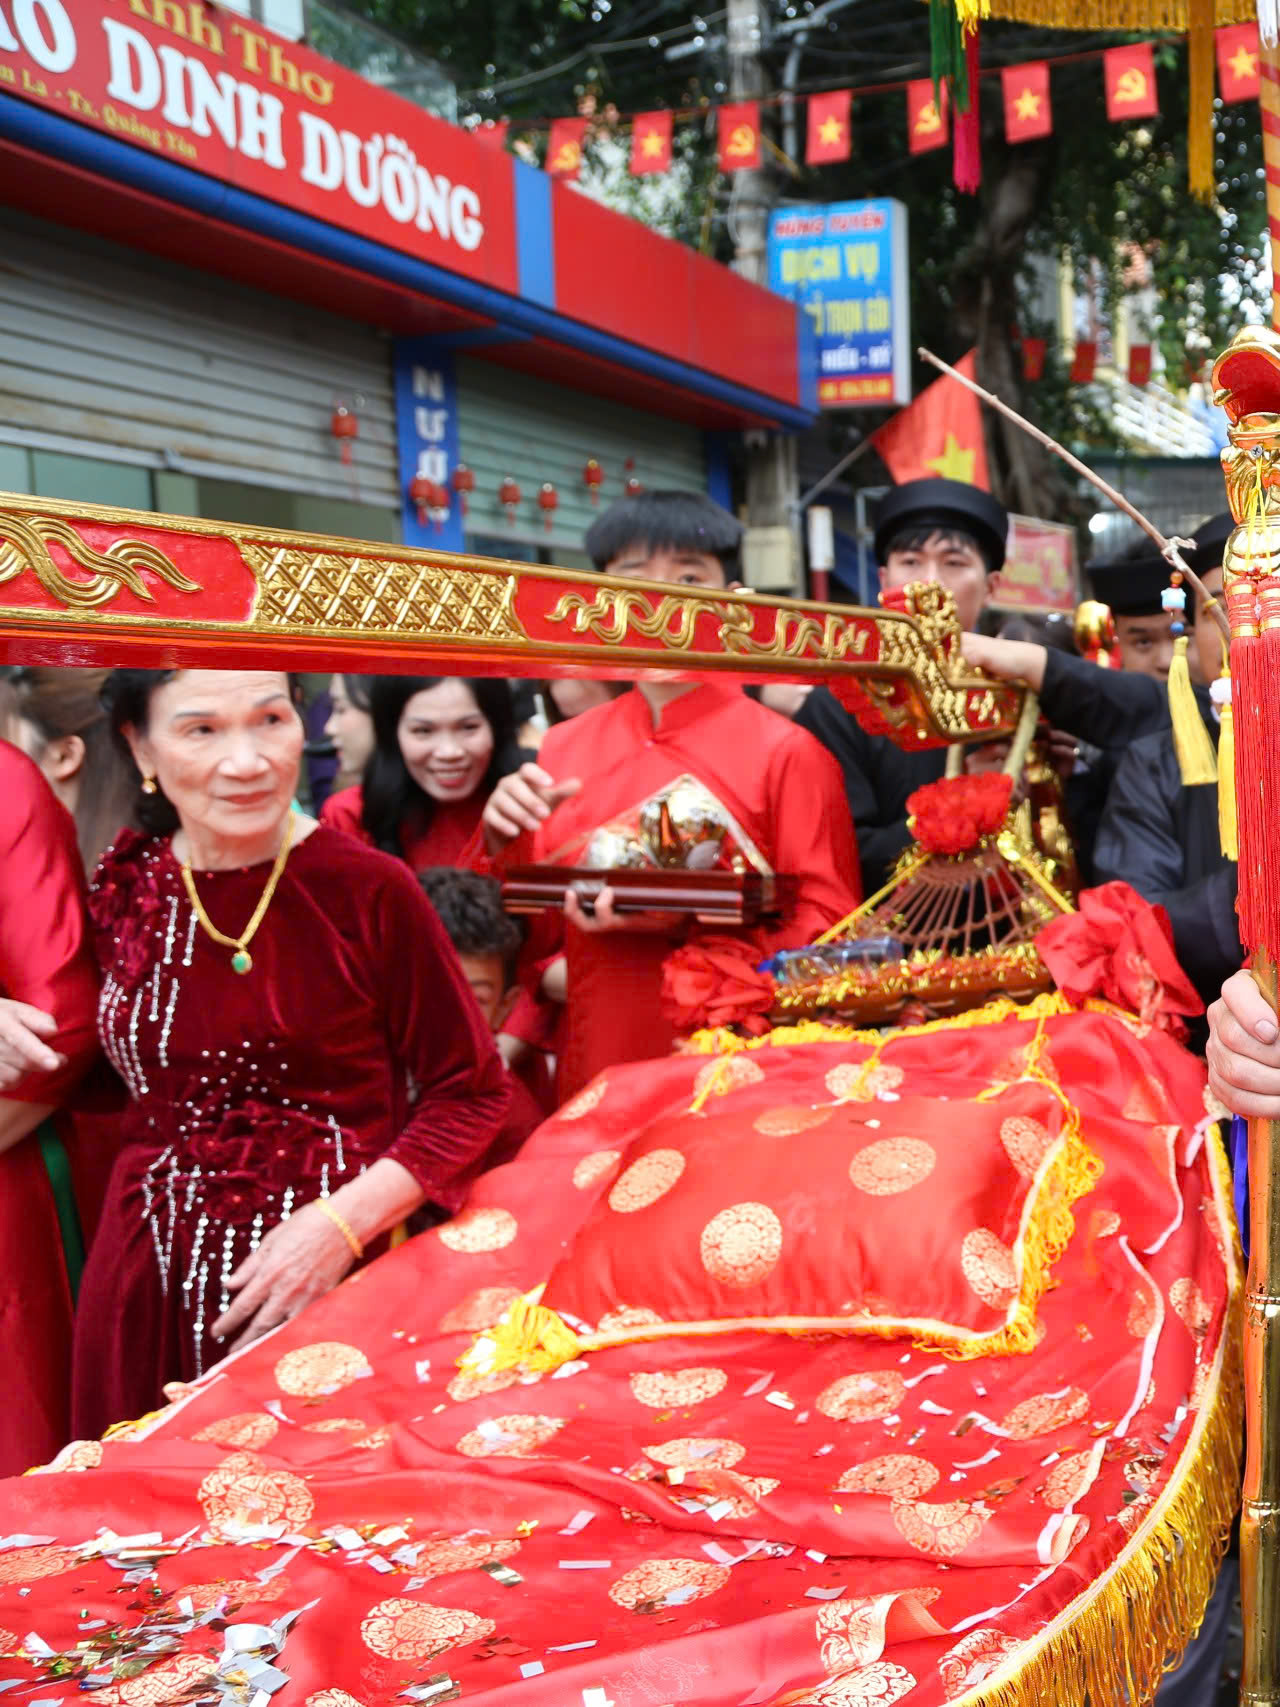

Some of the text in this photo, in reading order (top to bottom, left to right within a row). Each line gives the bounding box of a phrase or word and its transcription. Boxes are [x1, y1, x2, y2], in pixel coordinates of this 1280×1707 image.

[0, 0, 484, 251] O DINH DƯỠNG
[230, 23, 334, 105] Thơ
